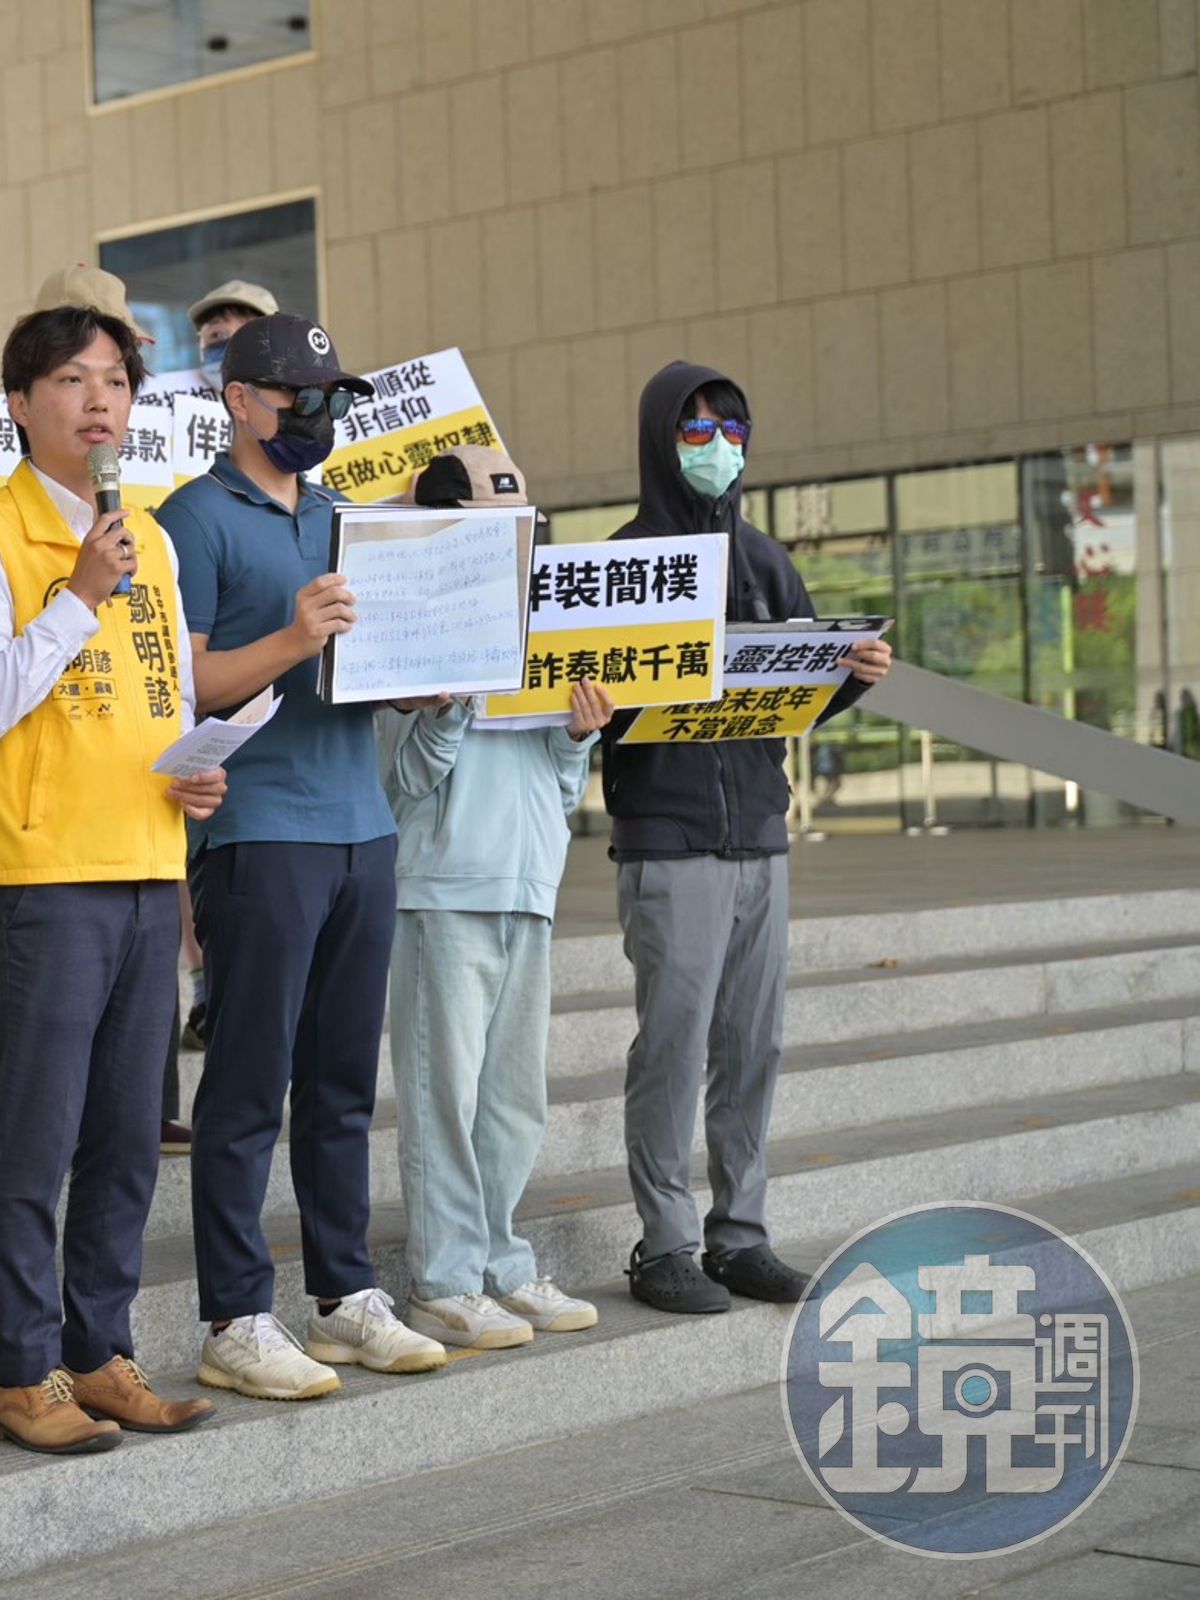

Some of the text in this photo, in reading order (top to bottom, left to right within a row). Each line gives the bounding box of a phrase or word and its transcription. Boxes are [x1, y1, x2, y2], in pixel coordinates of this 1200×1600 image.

[342, 396, 431, 441] 非信仰
[127, 583, 174, 718] 鄒明諺
[528, 641, 711, 689] 詐奉獻千萬
[723, 643, 853, 674] 靈控制
[662, 714, 785, 741] 不當觀念
